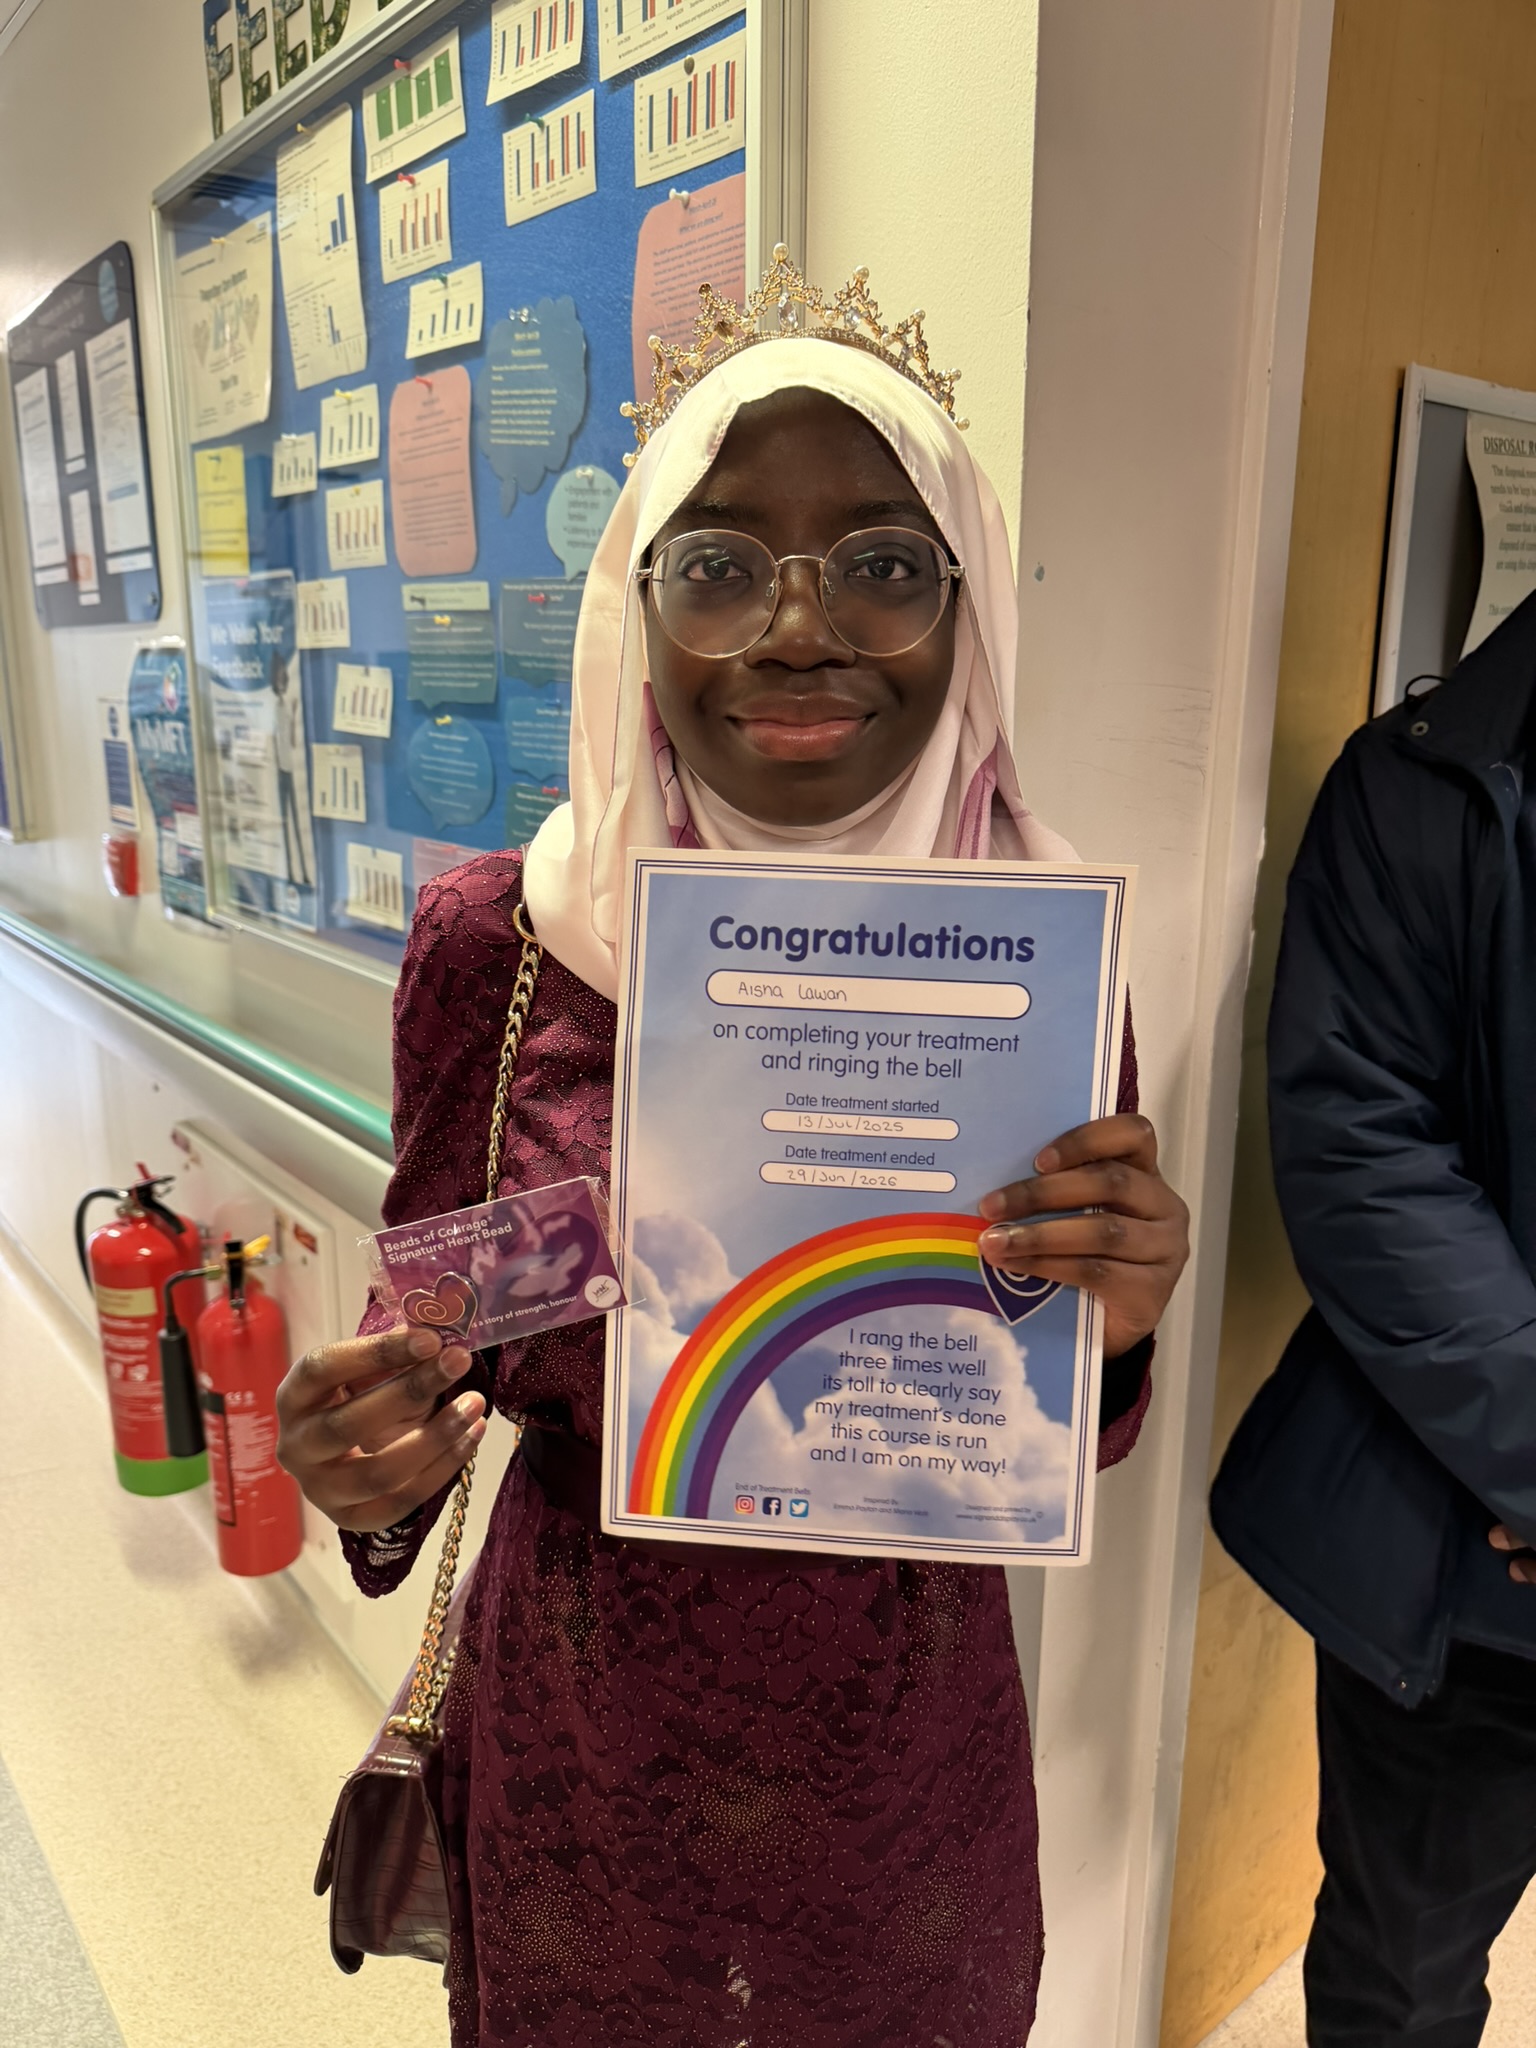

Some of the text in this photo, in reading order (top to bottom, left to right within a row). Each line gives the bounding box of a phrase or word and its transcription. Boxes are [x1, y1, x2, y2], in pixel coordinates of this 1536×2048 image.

[1483, 437, 1526, 455] DISPOSAL
[710, 916, 1035, 962] Congratulations
[713, 1022, 1020, 1052] on completing your treatment
[761, 1052, 962, 1080] and ringing the bell
[786, 1092, 940, 1114] Date treatment started
[785, 1145, 935, 1166] Date treatment ended
[383, 1234, 422, 1254] Beads
[423, 1230, 436, 1242] of
[388, 1222, 512, 1264] Signature Heart Bead
[484, 1314, 504, 1325] story
[505, 1311, 514, 1319] of
[514, 1303, 550, 1316] strength,
[549, 1295, 578, 1308] honour
[850, 1328, 978, 1352] I rang the bell
[838, 1352, 986, 1377] three times well
[822, 1374, 1002, 1406] its toll to clearly say
[815, 1401, 1007, 1426] my treatment's done
[830, 1422, 987, 1450] this course is run
[810, 1446, 1007, 1478] and I am on my way!
[735, 1482, 748, 1491] End
[750, 1484, 758, 1492] of
[758, 1484, 793, 1494] Treatment
